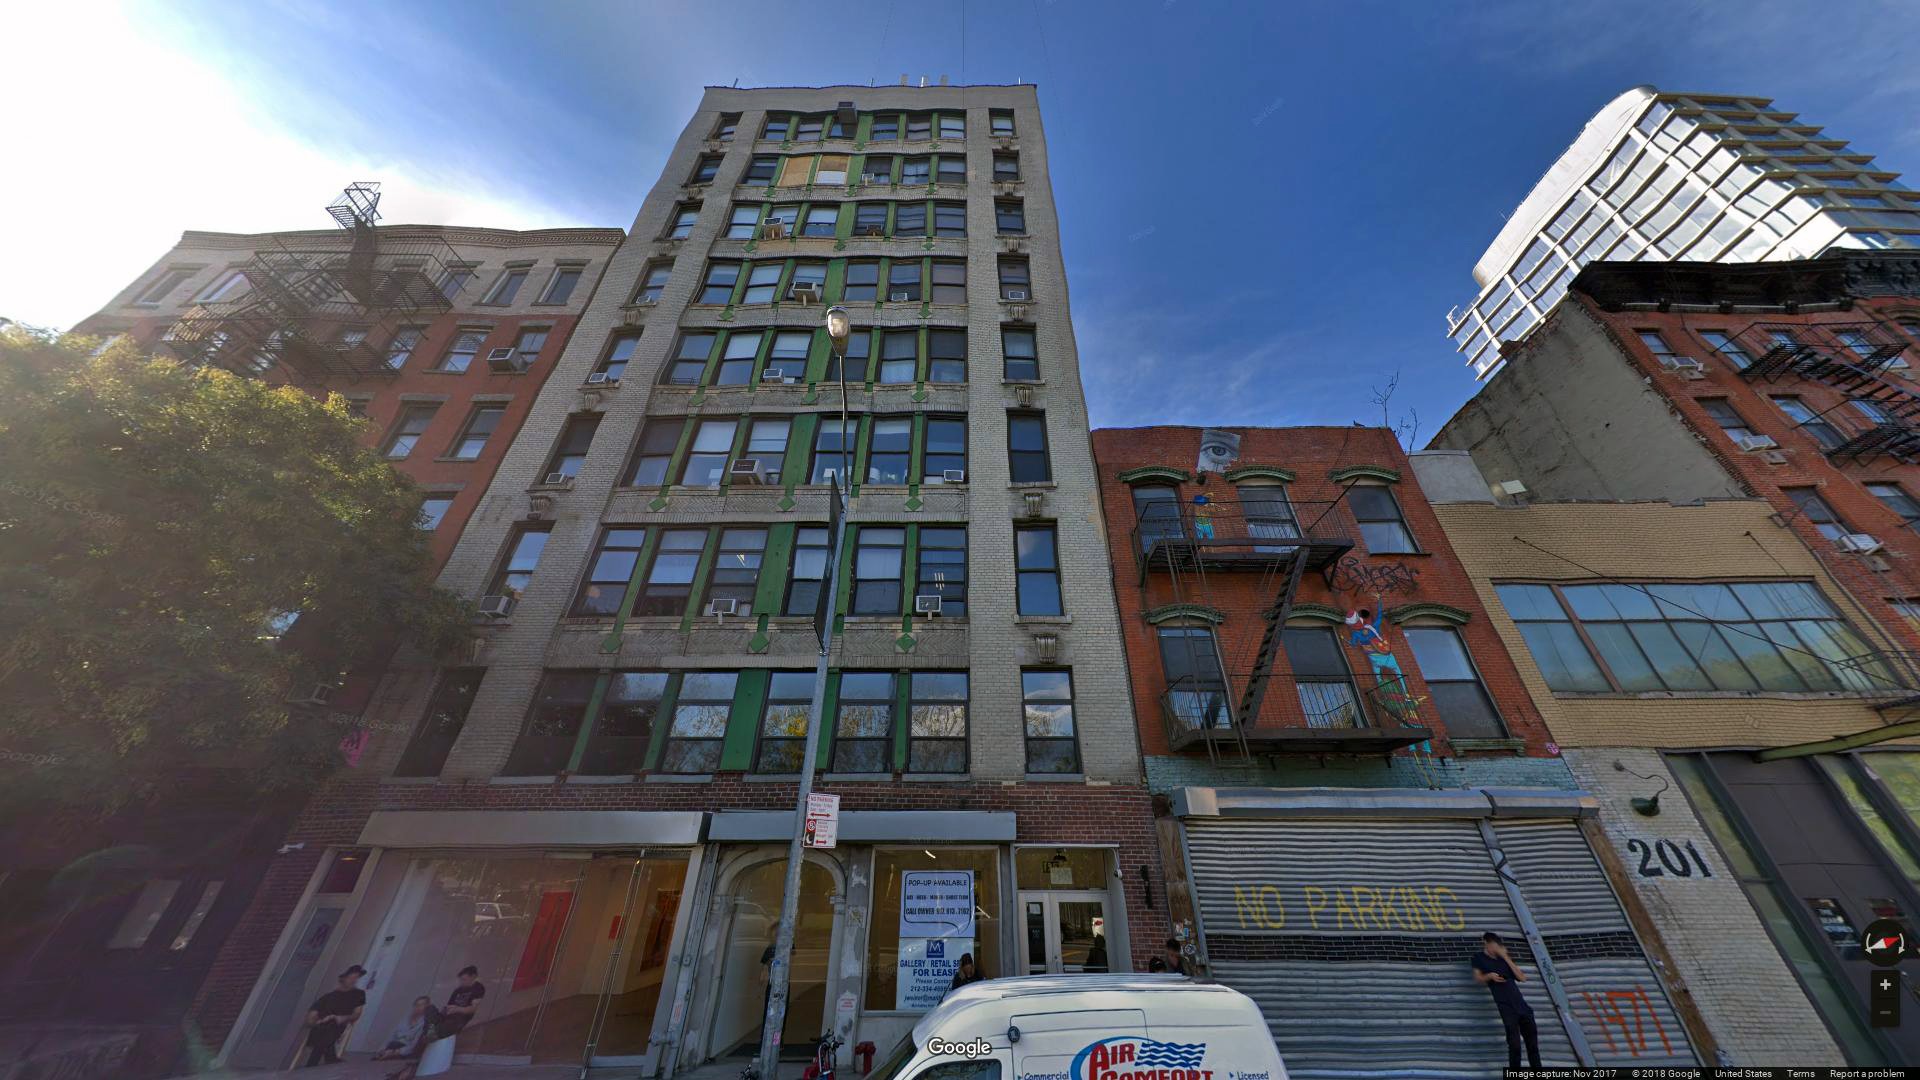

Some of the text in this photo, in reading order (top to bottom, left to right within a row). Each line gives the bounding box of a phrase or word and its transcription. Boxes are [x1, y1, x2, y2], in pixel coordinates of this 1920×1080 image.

[1627, 838, 1712, 878] 201
[1234, 885, 1465, 931] NO PARKING
[900, 960, 925, 968] GALLERY
[1582, 984, 1675, 1057] 1471
[1024, 1071, 1069, 1080] Commercial
[1237, 1071, 1269, 1080] Licensed
[1089, 1043, 1135, 1080] AIR
